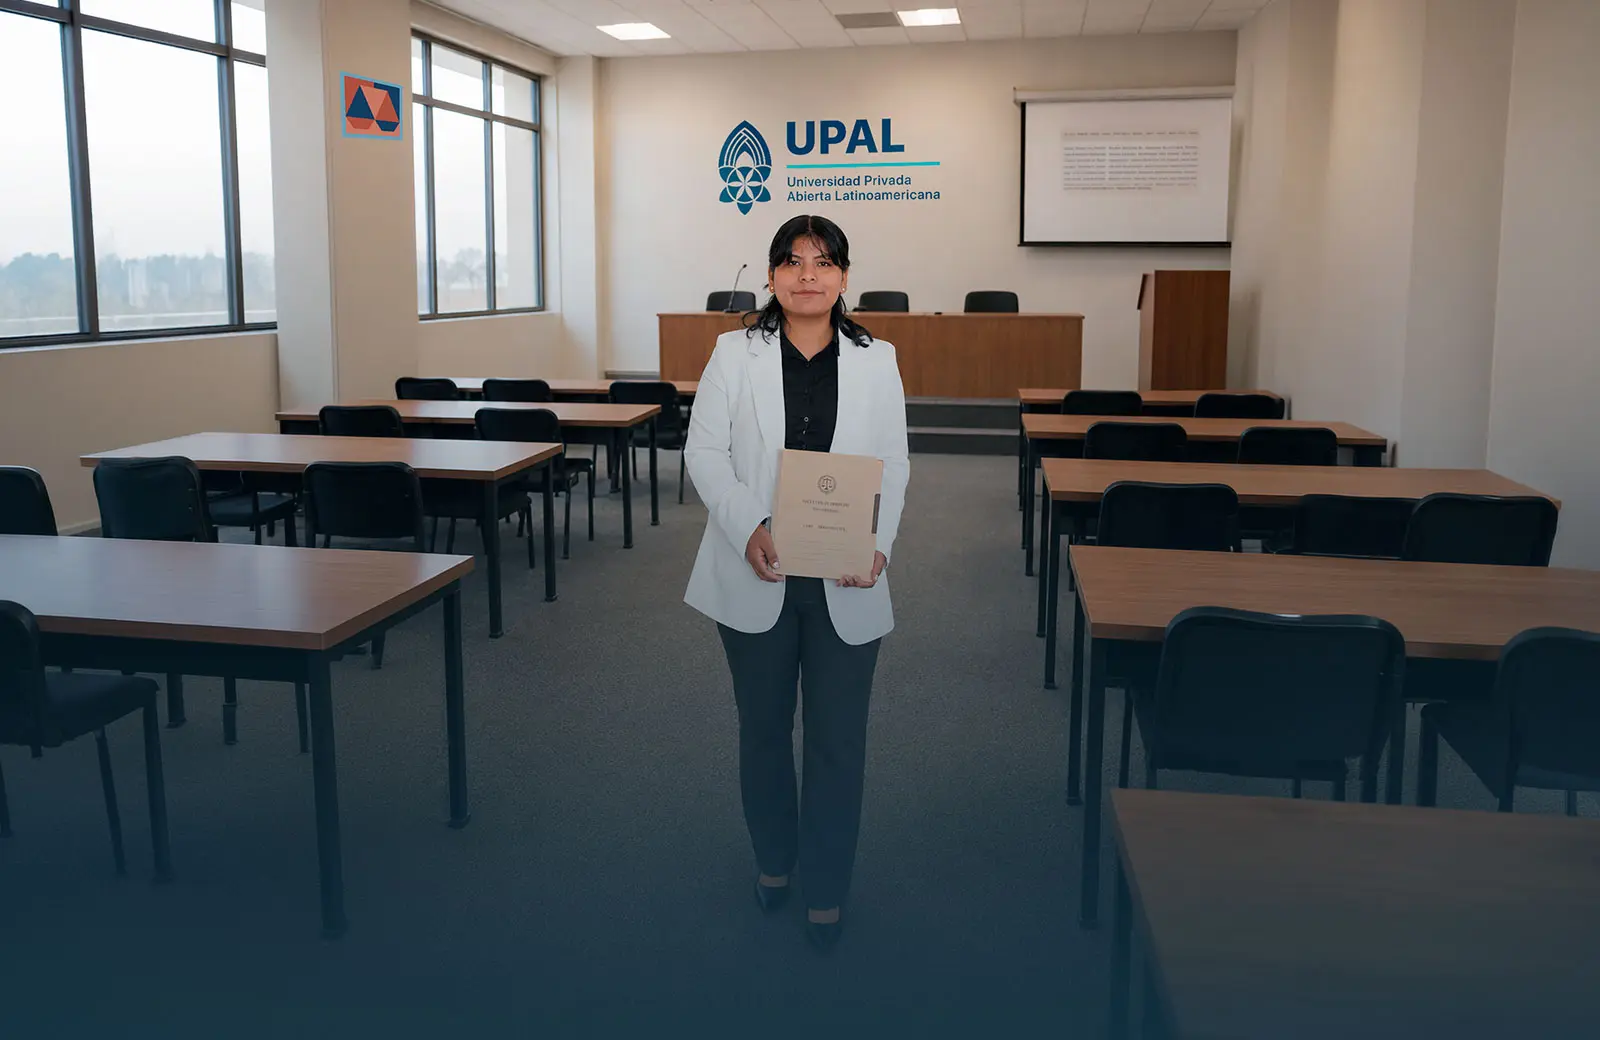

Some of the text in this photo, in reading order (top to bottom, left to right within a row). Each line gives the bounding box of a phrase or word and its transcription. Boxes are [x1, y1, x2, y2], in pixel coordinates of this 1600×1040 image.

[785, 117, 906, 156] UPAL
[786, 174, 912, 188] Universidad Privada
[786, 190, 941, 202] Abierta Latinoamericana
